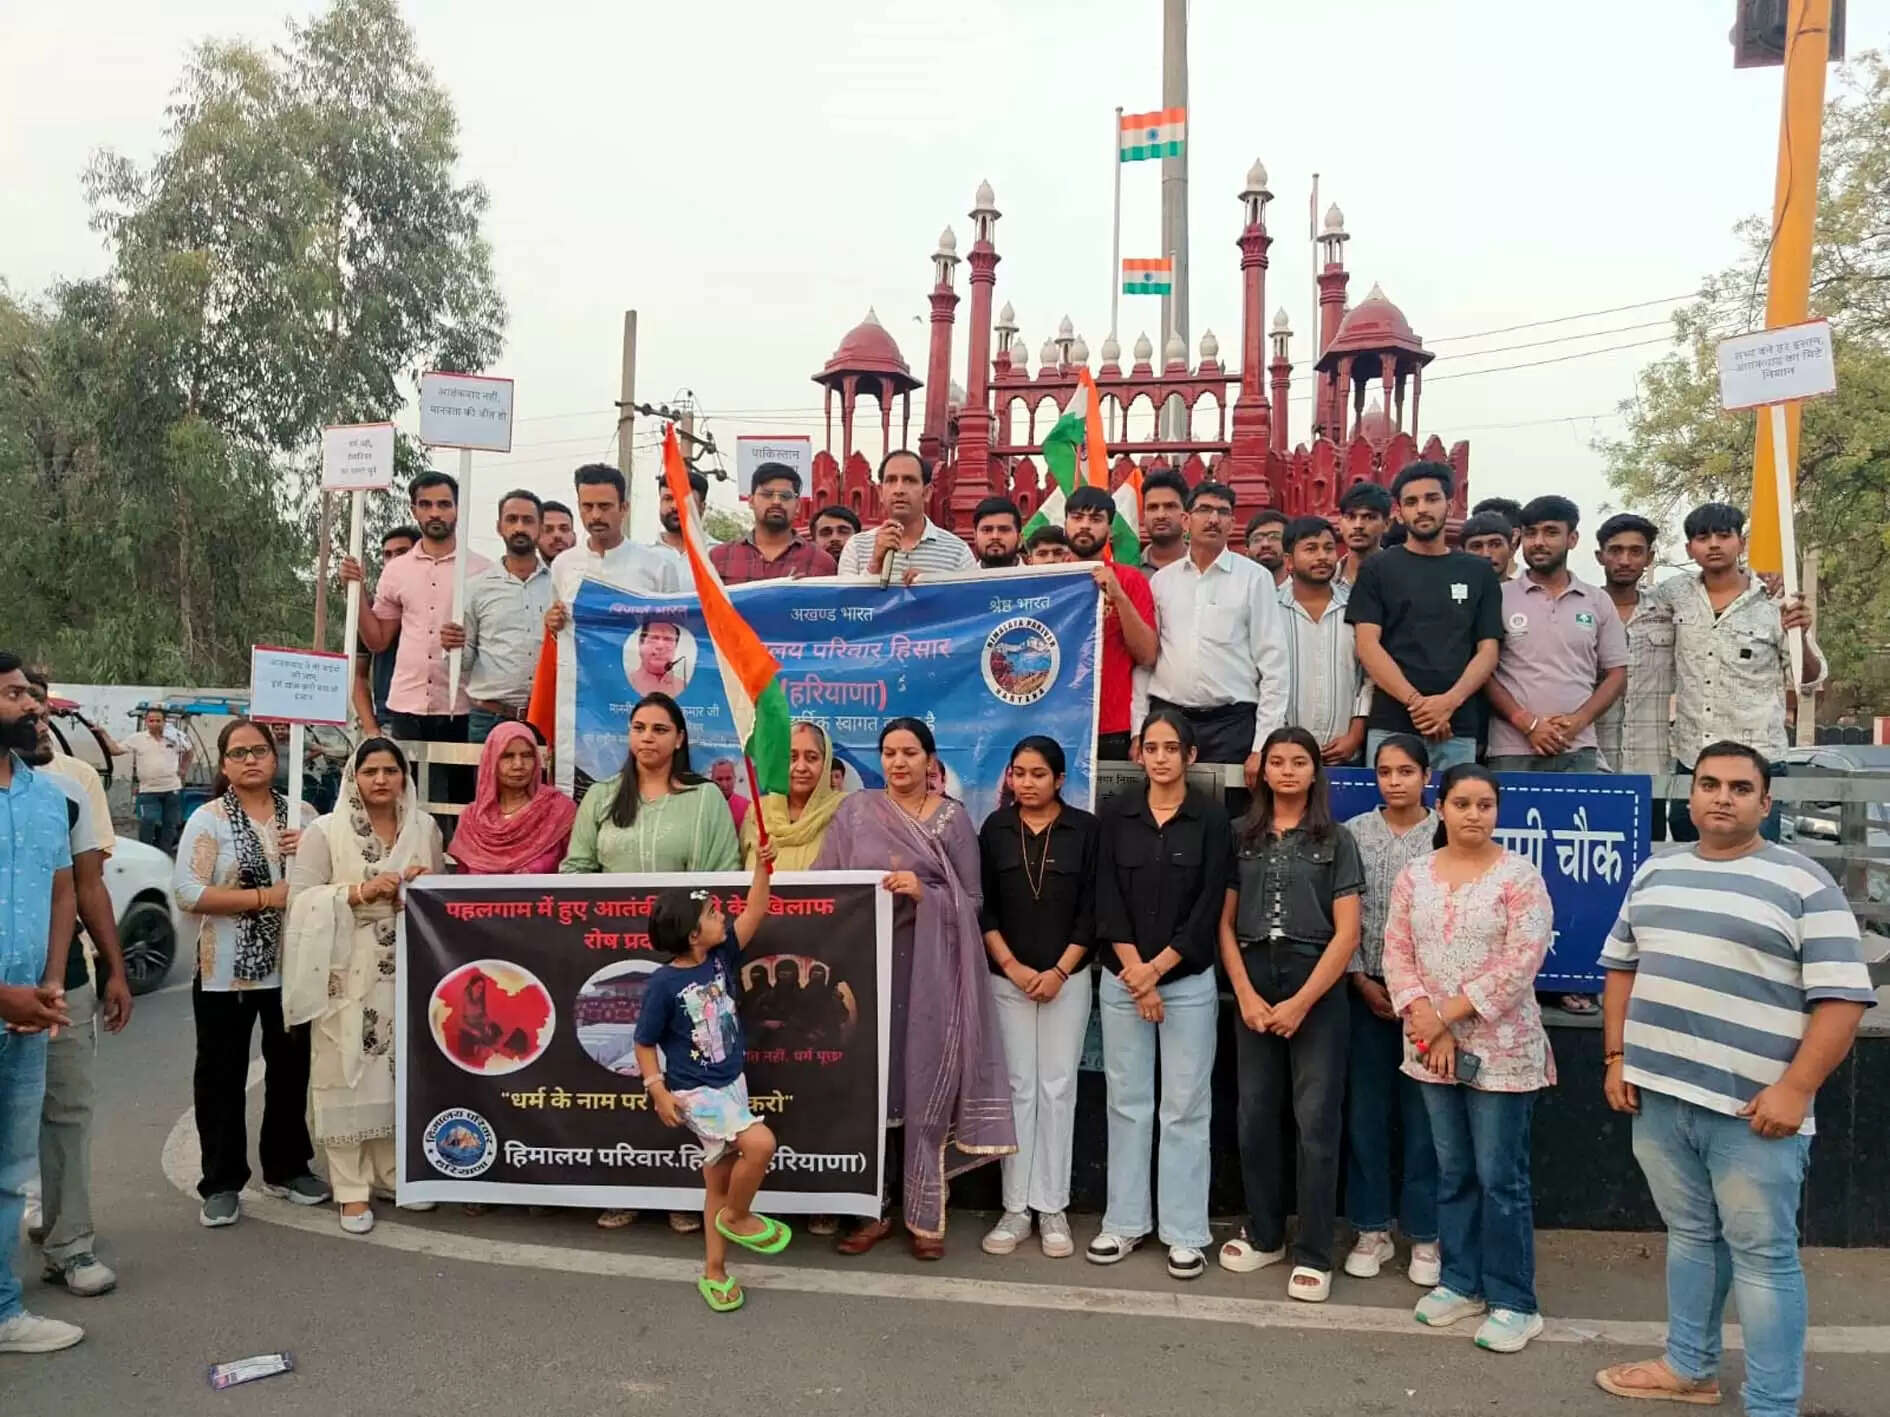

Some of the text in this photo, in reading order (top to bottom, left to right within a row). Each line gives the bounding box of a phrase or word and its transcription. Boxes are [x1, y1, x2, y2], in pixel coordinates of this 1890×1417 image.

[752, 446, 800, 459] पाकिस्तान
[791, 607, 875, 622] अखण्ड भारत
[1017, 597, 1051, 609] भारत
[987, 619, 1056, 649] HIMALAYA PARIVAR
[812, 637, 884, 658] परिवार
[888, 634, 952, 661] हिसार
[780, 674, 888, 711] (हरियाणा)
[835, 715, 878, 732] स्वागत
[1552, 805, 1626, 885] चौक
[446, 901, 533, 921] पहलगाम
[535, 896, 554, 917] में
[557, 901, 589, 925] हुए
[584, 928, 620, 949] रोष
[550, 1086, 572, 1109] के
[575, 1094, 616, 1110] नाम
[620, 1094, 648, 1110] पर
[503, 1139, 594, 1168] हिमालय
[764, 1145, 867, 1174] रियाणा)
